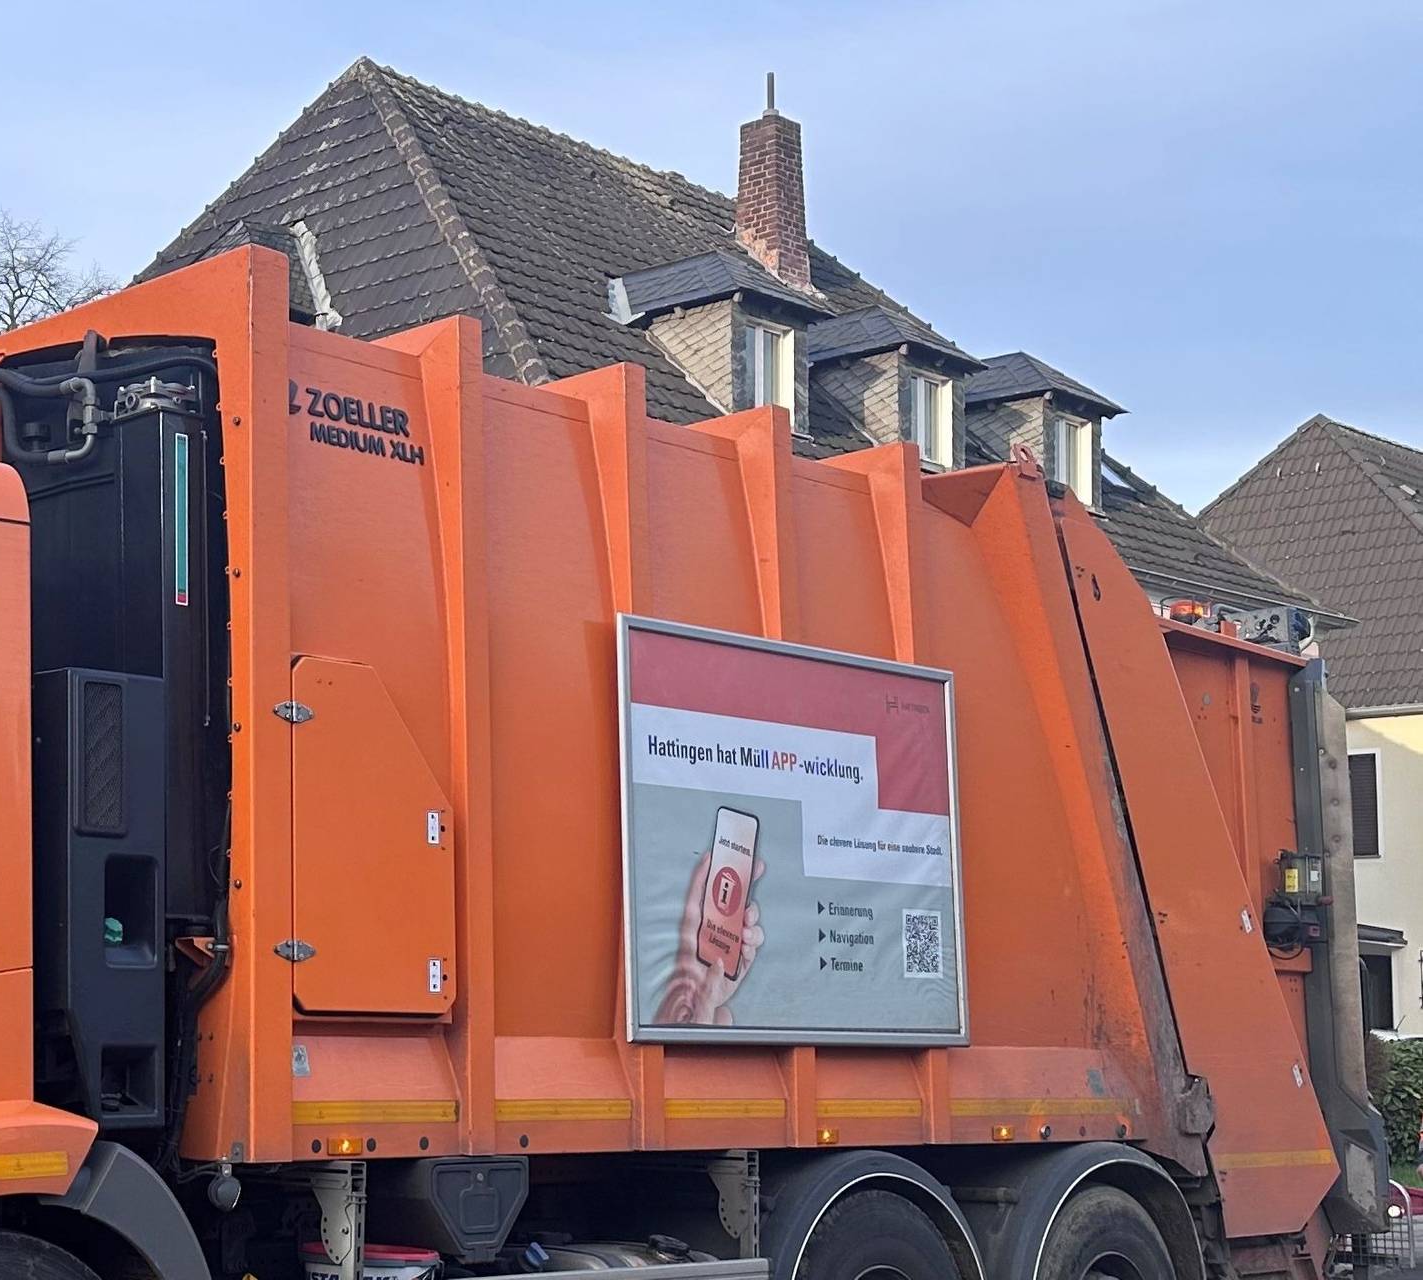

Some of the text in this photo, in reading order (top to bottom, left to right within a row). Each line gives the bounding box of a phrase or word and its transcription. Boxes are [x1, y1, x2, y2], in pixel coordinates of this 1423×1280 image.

[306, 387, 410, 438] ZOELLER
[310, 422, 424, 466] MEDIUM XLH
[647, 734, 864, 784] Hattingen hat Müll APP -wicklung.
[829, 902, 874, 921] Erinnerung
[830, 929, 874, 947] Navigation
[831, 957, 864, 972] Termine
